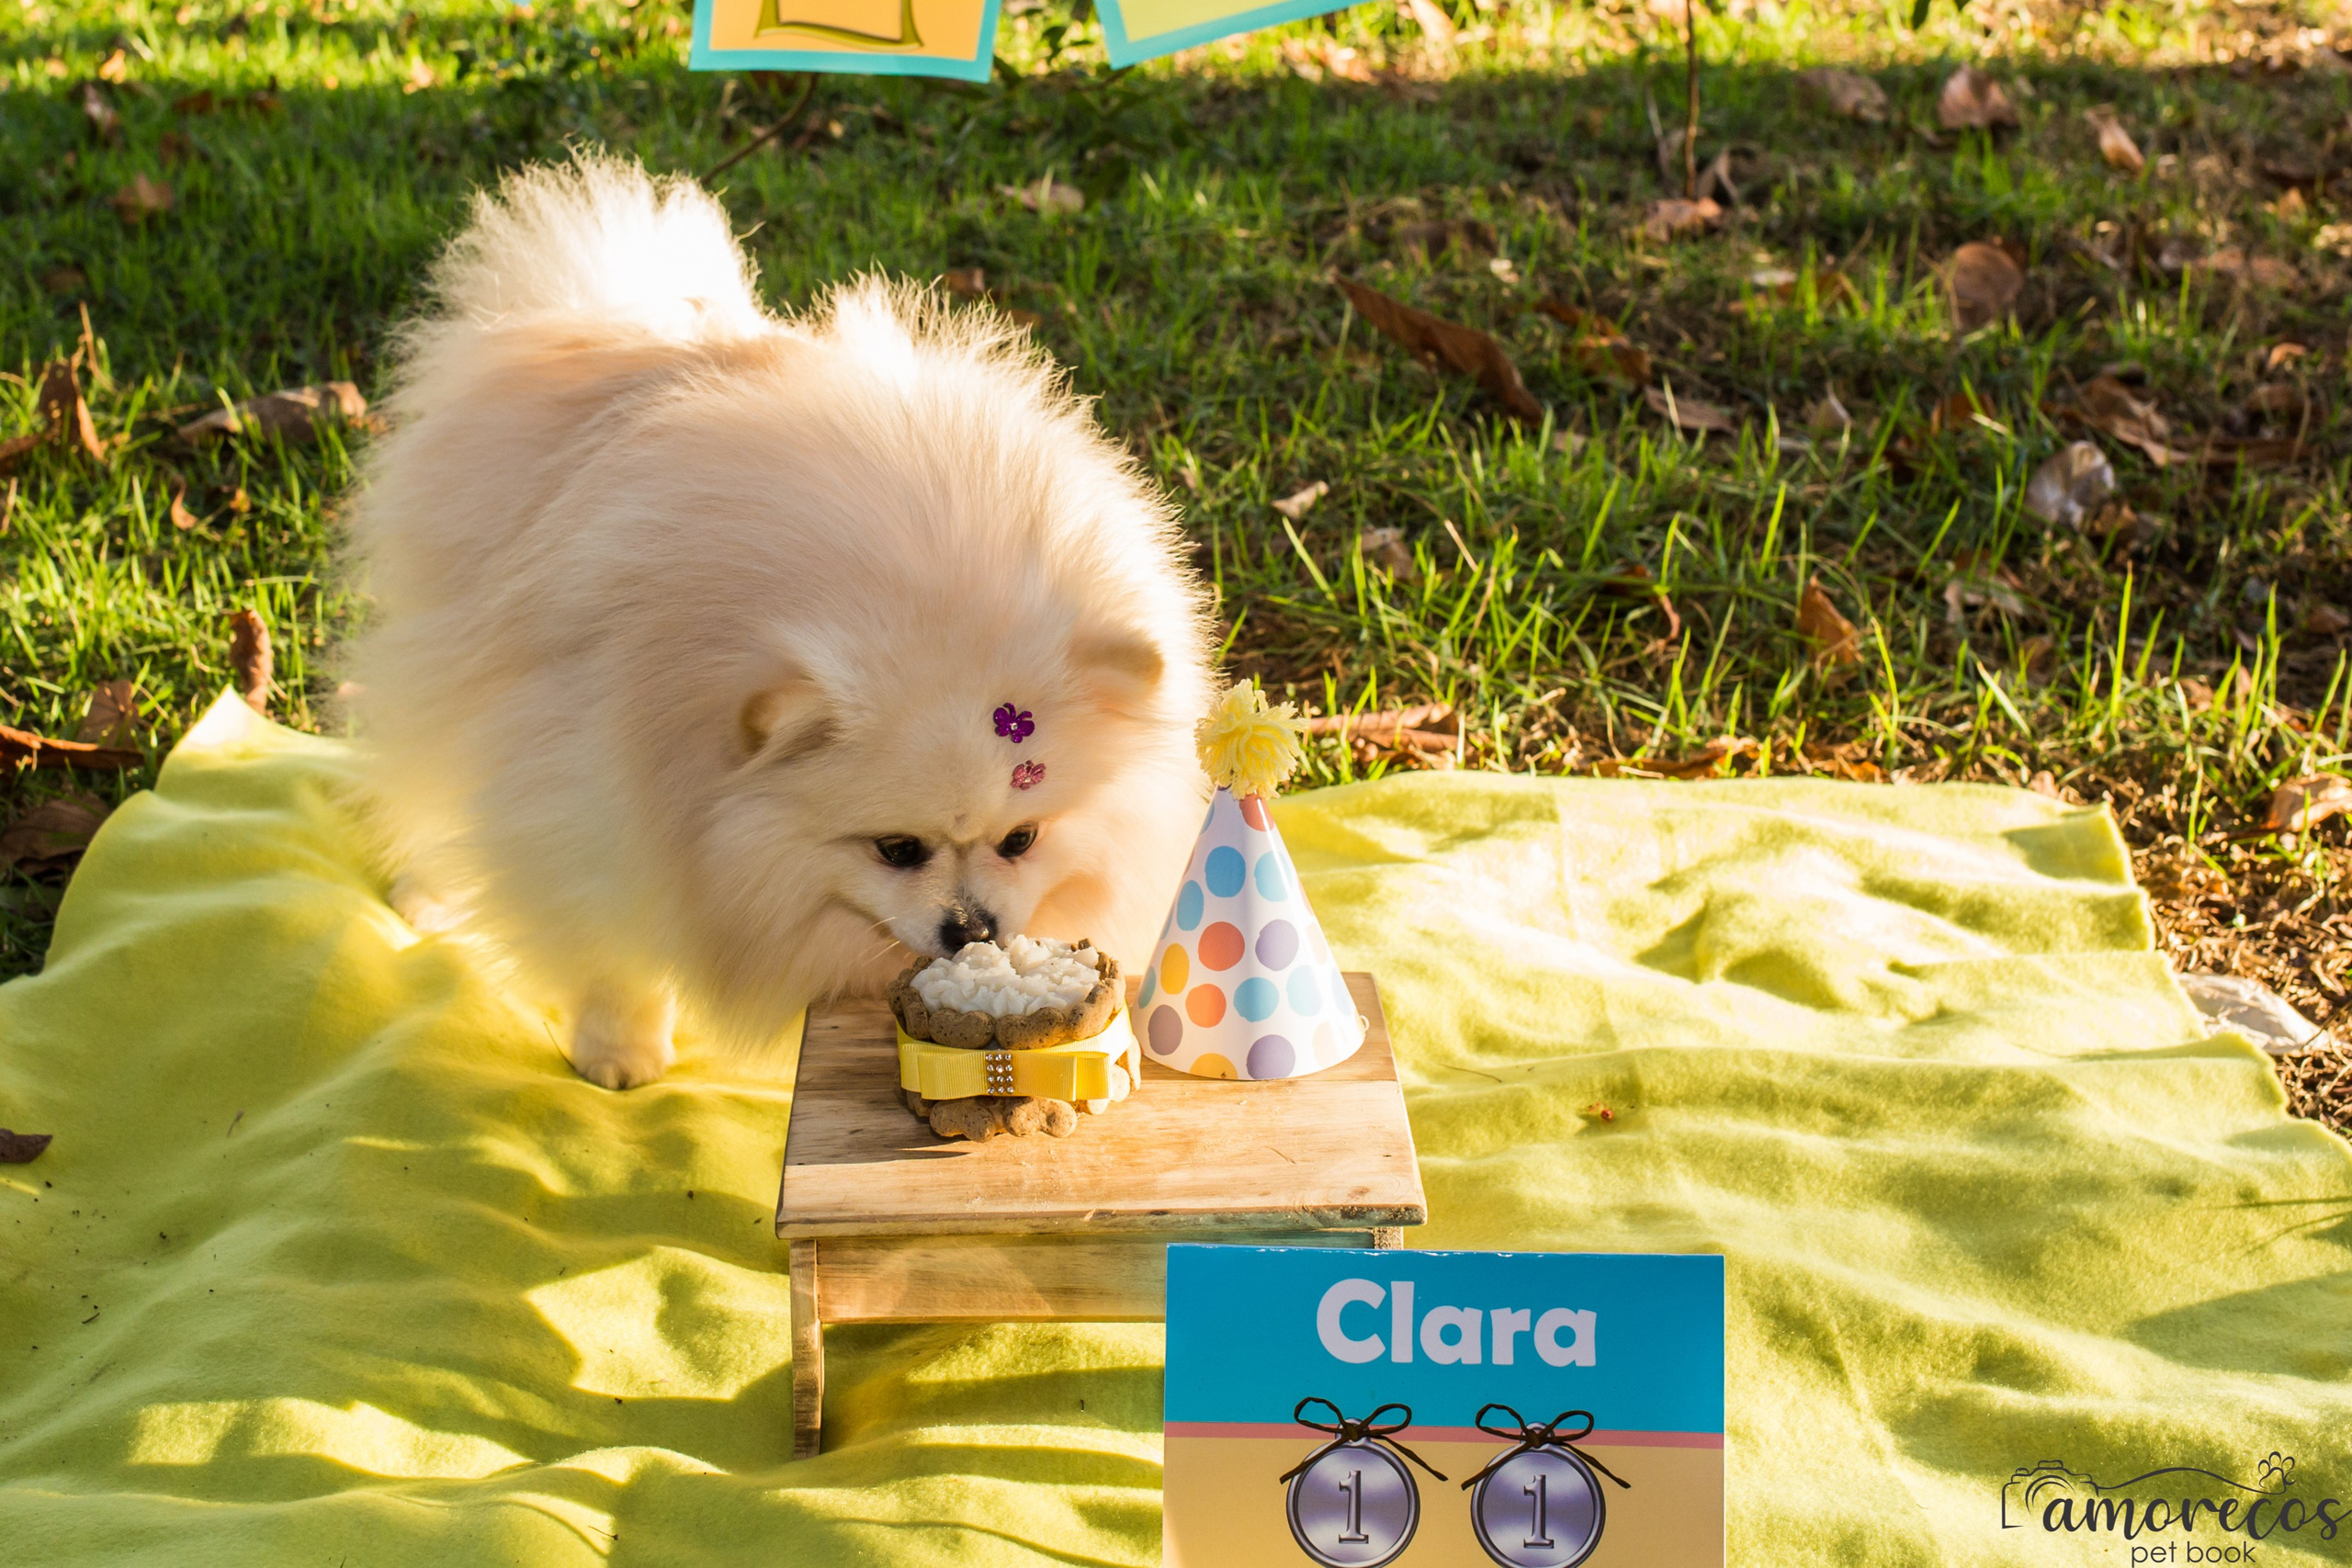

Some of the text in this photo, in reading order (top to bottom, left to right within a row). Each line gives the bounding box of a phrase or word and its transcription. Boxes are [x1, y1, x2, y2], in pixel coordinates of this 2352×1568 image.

[1316, 1278, 1597, 1367] Clara
[1339, 1470, 1555, 1549] 1 1
